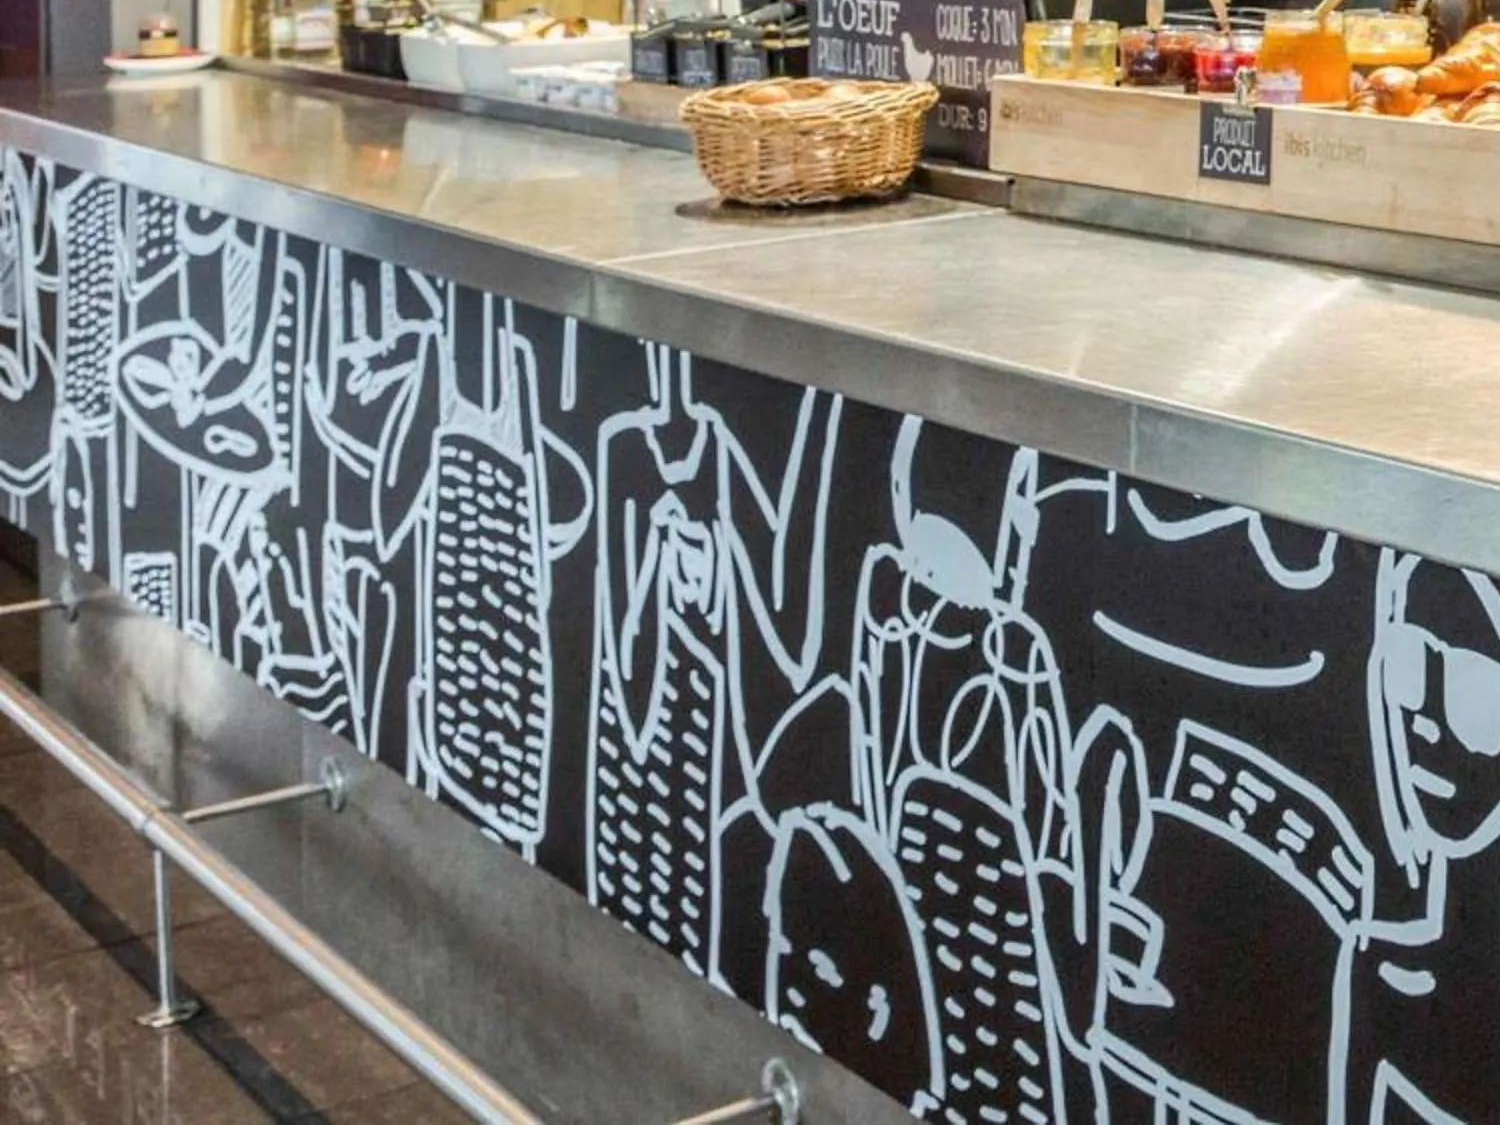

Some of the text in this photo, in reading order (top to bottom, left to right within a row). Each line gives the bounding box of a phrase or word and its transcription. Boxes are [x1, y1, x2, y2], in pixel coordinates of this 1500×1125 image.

[980, 7, 989, 44] 3
[993, 8, 1018, 46] MIN
[846, 41, 862, 75] LA
[938, 103, 988, 133] DUR: 9
[1213, 117, 1256, 146] PRODUIT
[1202, 144, 1266, 176] LOCAL
[1284, 131, 1367, 165] ibis kitchen
